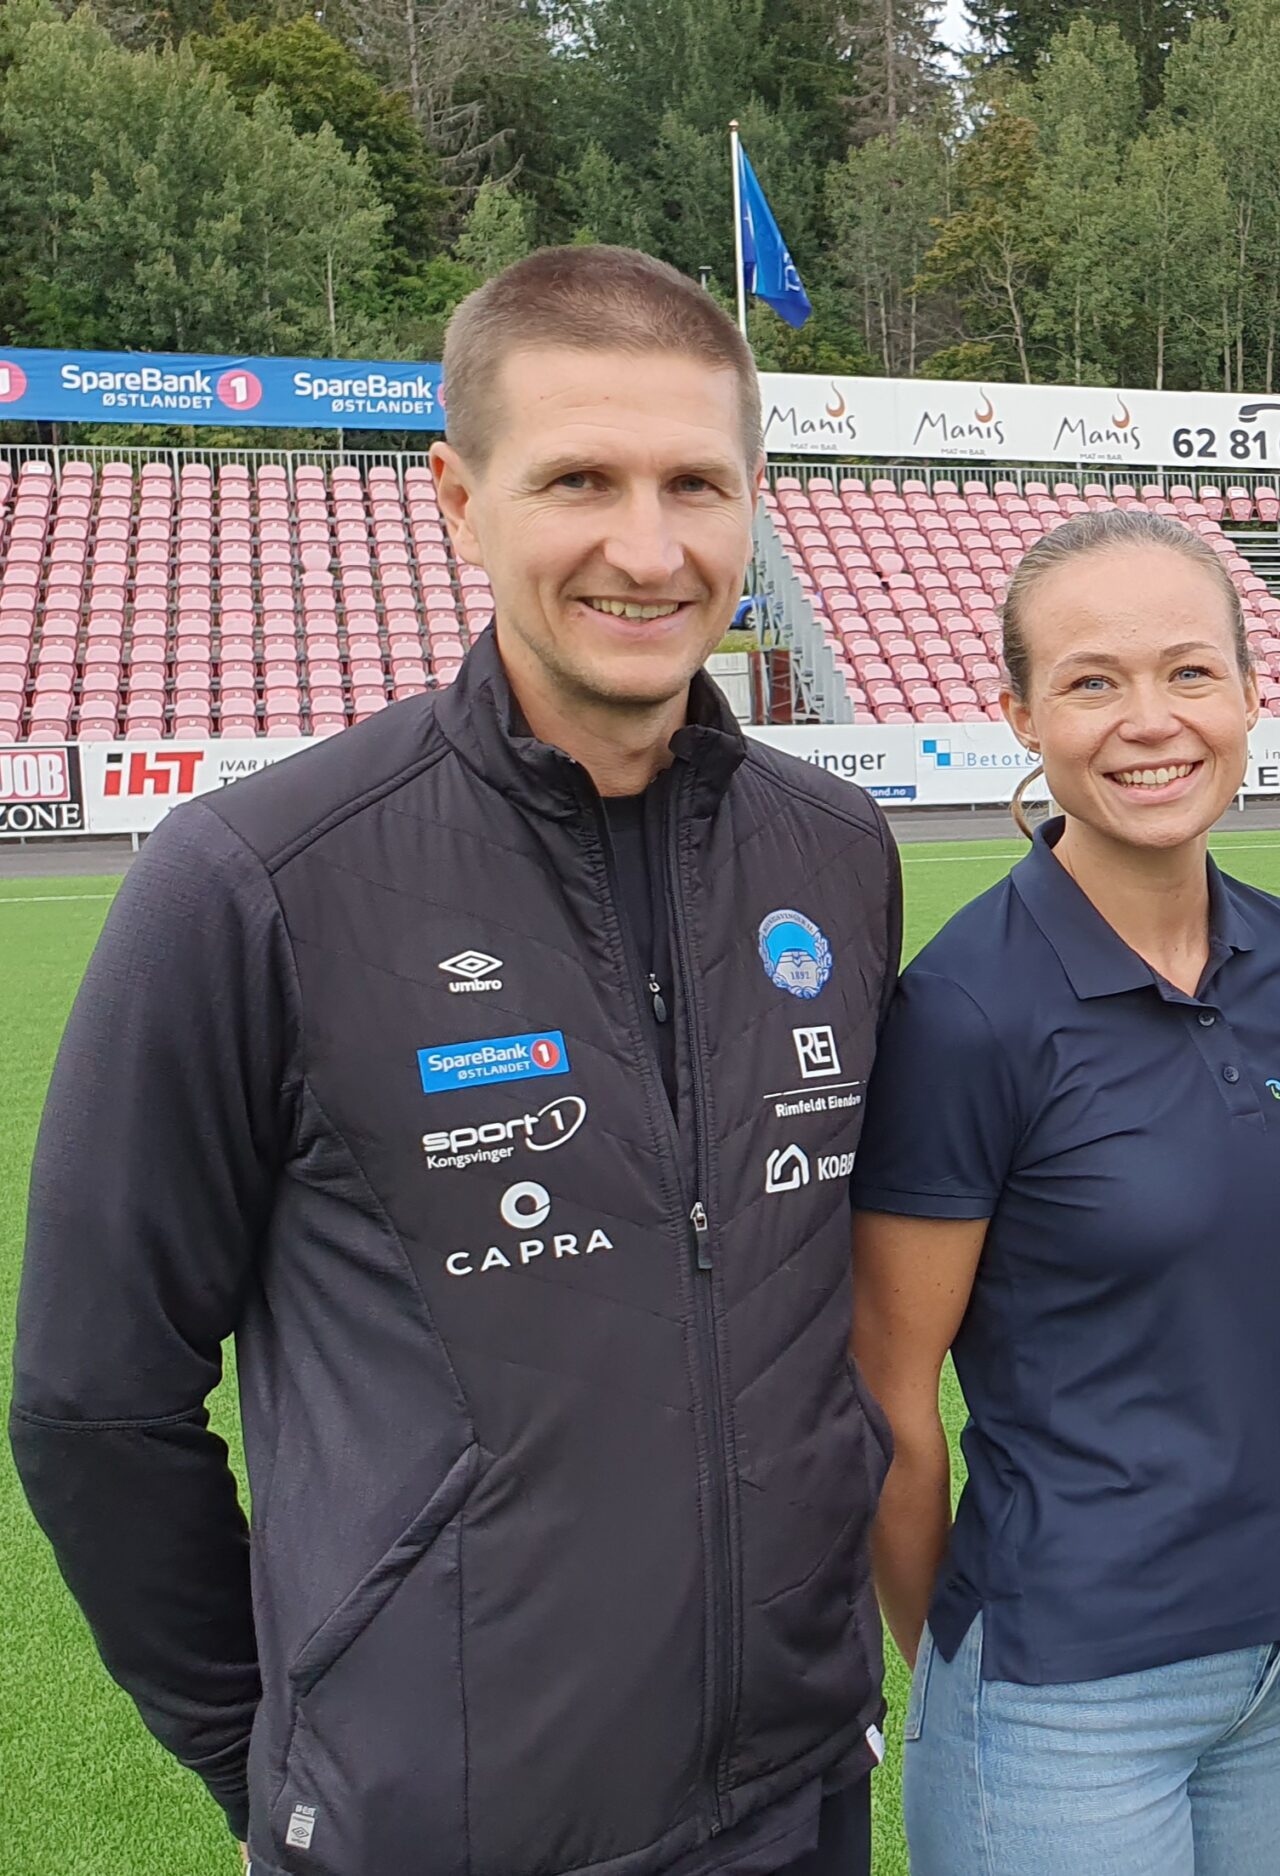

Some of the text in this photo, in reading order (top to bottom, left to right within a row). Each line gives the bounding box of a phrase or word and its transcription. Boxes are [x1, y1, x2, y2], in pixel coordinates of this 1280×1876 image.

[61, 364, 248, 404] SpareBank 1
[294, 372, 433, 400] SpareBank
[102, 392, 213, 410] ØSTLANDET
[331, 398, 434, 415] ØSTLANDET
[913, 410, 1005, 445] Manis
[1053, 416, 1141, 450] Manis
[1172, 427, 1218, 459] 62
[1229, 429, 1268, 460] 81
[219, 759, 259, 773] IVAR
[448, 978, 503, 993] umbro
[427, 1043, 552, 1073] SpareBank 1
[457, 1060, 532, 1081] ØSTLANDET
[774, 1098, 828, 1118] Rimfeldt
[422, 1109, 566, 1154] sport 1
[426, 1146, 515, 1170] Kongsvinger
[445, 1228, 614, 1276] CAPRA
